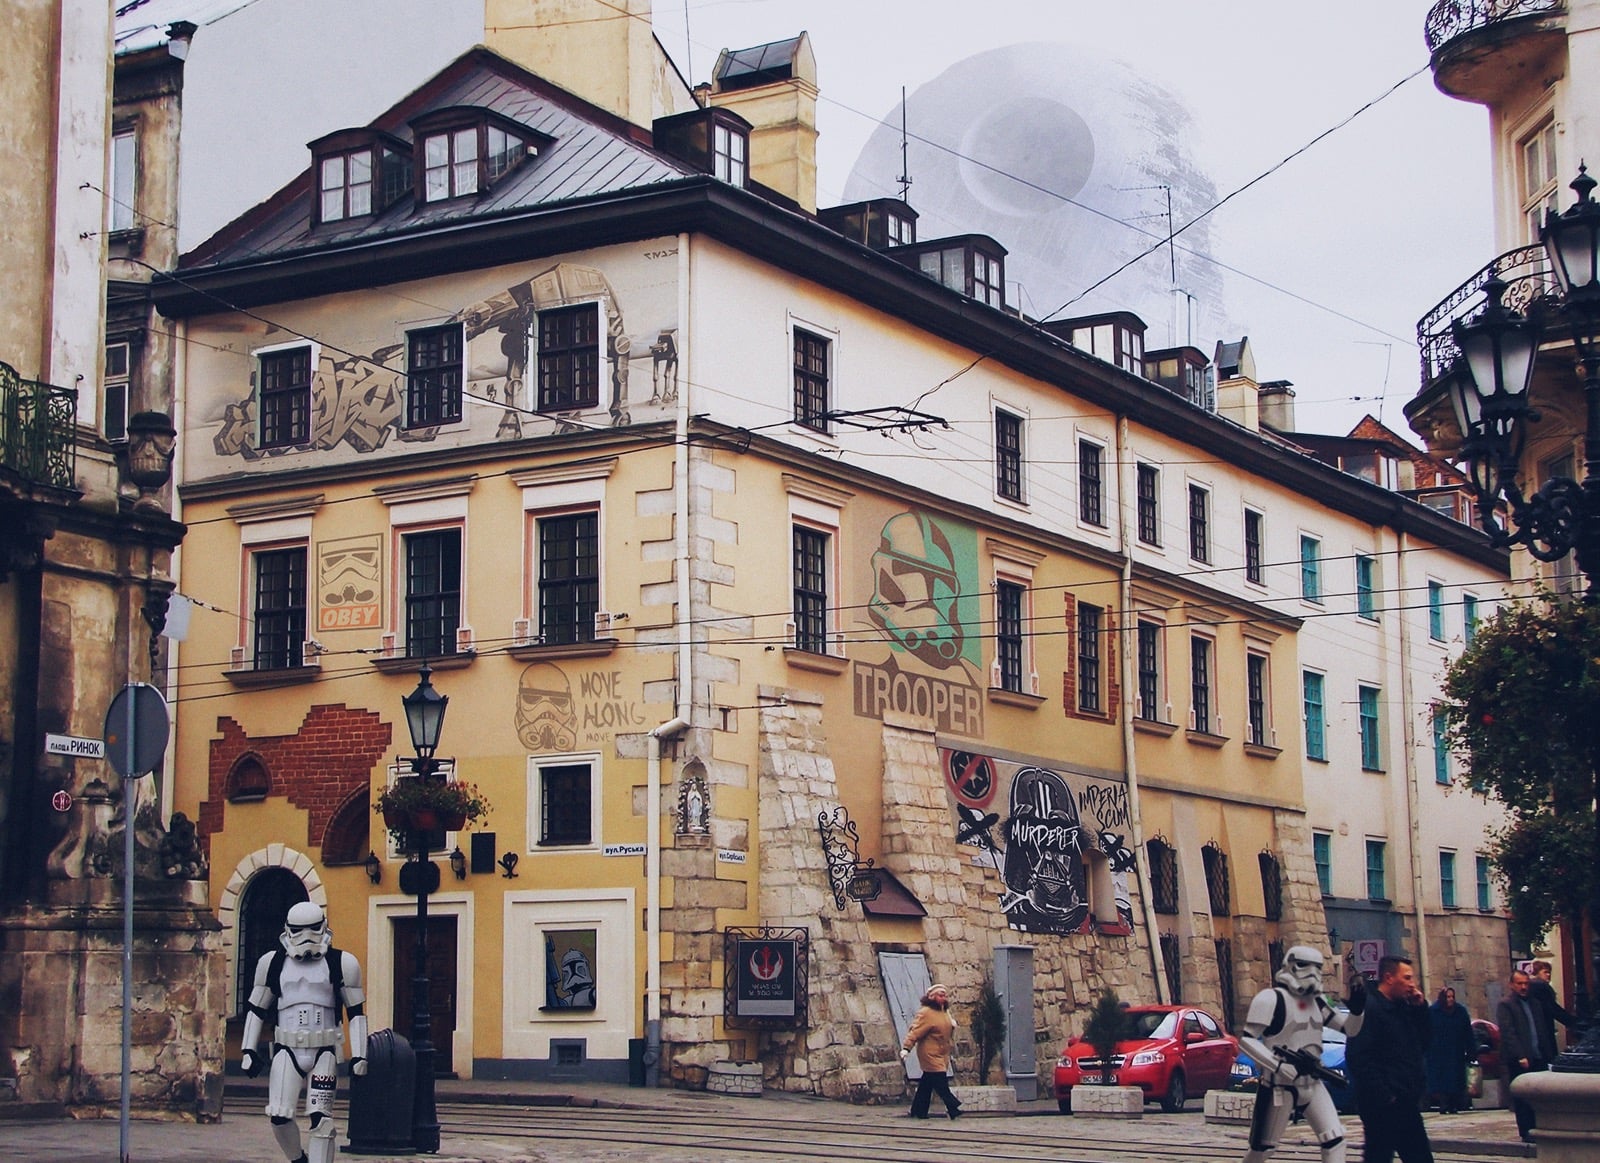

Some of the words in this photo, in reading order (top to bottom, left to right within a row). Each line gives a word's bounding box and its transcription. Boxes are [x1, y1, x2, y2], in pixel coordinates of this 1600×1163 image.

[323, 606, 377, 627] OBEY
[580, 671, 622, 699] MOVE
[856, 664, 983, 737] TROOPER
[583, 701, 646, 729] ALONG
[71, 740, 100, 755] РИНОК
[586, 732, 610, 743] MOVE
[1096, 800, 1132, 832] SCUM
[1011, 819, 1083, 858] MURDERER
